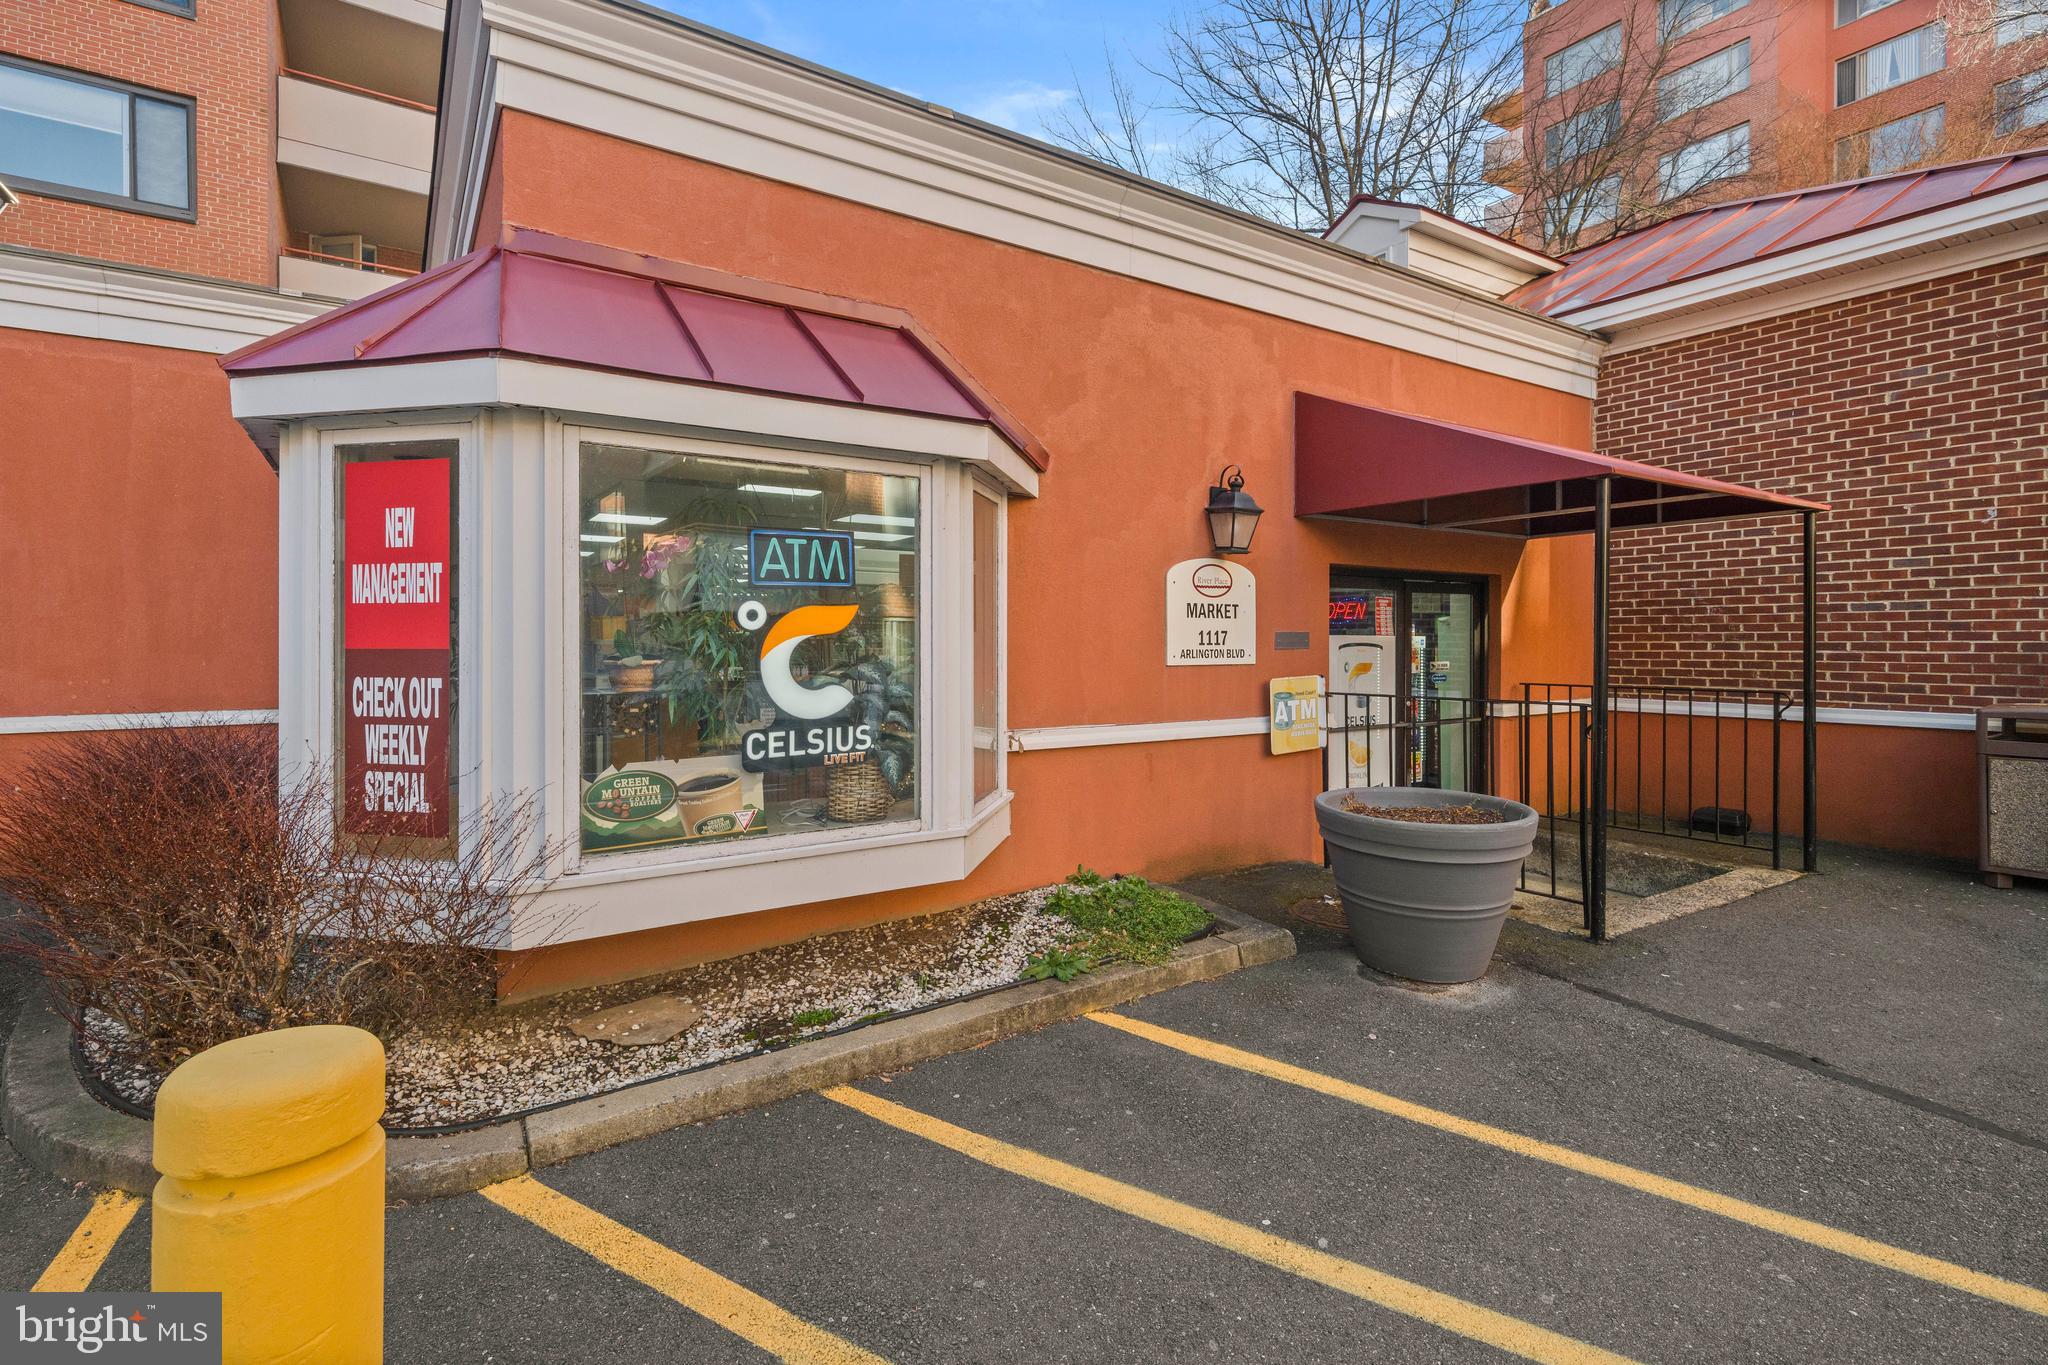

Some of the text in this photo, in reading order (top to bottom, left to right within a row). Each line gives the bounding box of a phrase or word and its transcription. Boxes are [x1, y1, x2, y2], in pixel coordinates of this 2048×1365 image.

[385, 507, 415, 548] NEW
[760, 537, 845, 580] ATM
[352, 562, 442, 604] MANAGEMENT
[1186, 603, 1239, 619] MARKET
[1198, 631, 1228, 646] 1117
[1180, 648, 1245, 659] ARLINGTON BLVD
[352, 676, 442, 719] CHECK OUT
[1274, 698, 1316, 723] ATM
[364, 724, 429, 766] WEEKLY
[823, 751, 866, 766] LIVE FIT
[364, 771, 430, 813] SPECIAL
[601, 785, 661, 800] MOUNTAIN
[613, 777, 650, 788] GREEN
